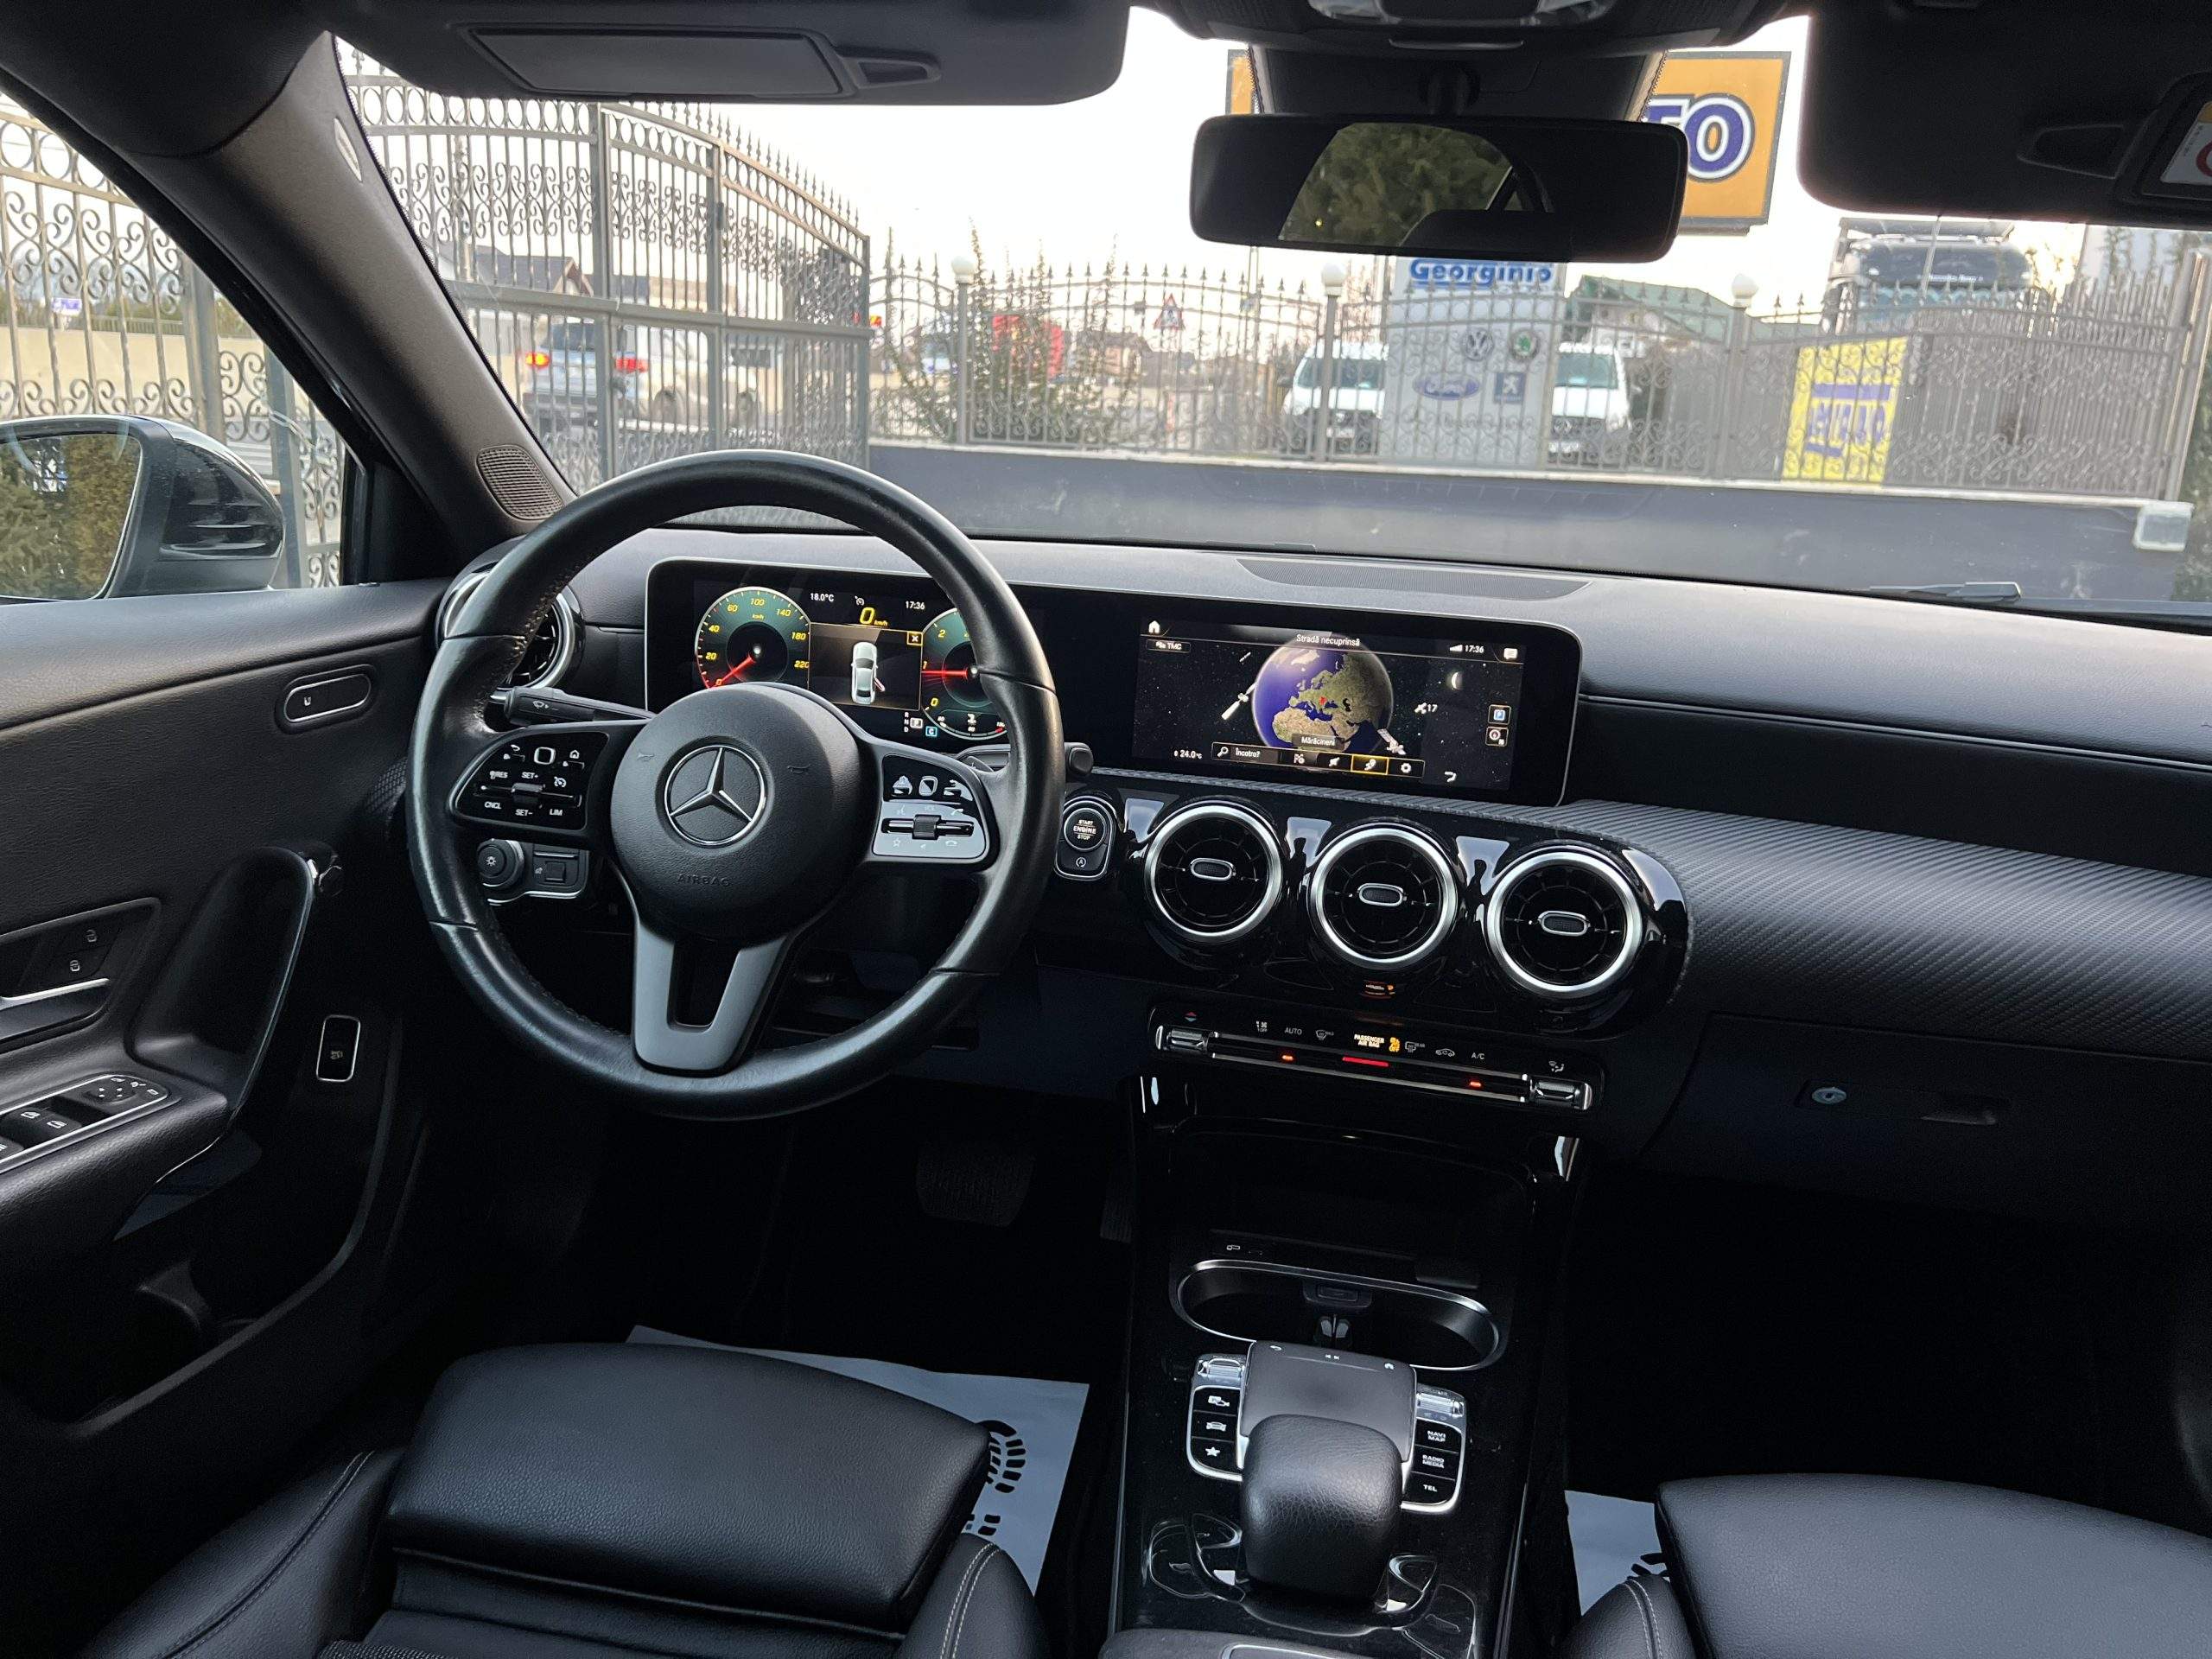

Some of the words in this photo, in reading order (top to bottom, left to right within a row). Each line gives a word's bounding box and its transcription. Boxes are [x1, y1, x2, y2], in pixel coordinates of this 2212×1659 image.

[750, 598, 766, 607] 100
[905, 600, 925, 610] 17:36
[727, 603, 738, 613] 60
[776, 608, 791, 617] 140
[859, 607, 875, 626] 0
[709, 624, 720, 632] 40
[791, 632, 807, 641] 180
[938, 629, 946, 639] 2
[1464, 645, 1485, 654] 17:36
[705, 652, 717, 661] 20
[794, 659, 810, 669] 220
[930, 697, 939, 707] 0
[1427, 703, 1438, 713] 17
[1073, 826, 1096, 835] ENGINE
[1284, 1027, 1303, 1036] AUTO
[1353, 1034, 1385, 1044] PASSENGER
[1471, 1052, 1485, 1060] A/C
[1427, 1430, 1446, 1439] NAVI
[1422, 1454, 1445, 1463] RADIO
[1422, 1459, 1445, 1469] MEDIA
[1423, 1484, 1438, 1492] TEL
